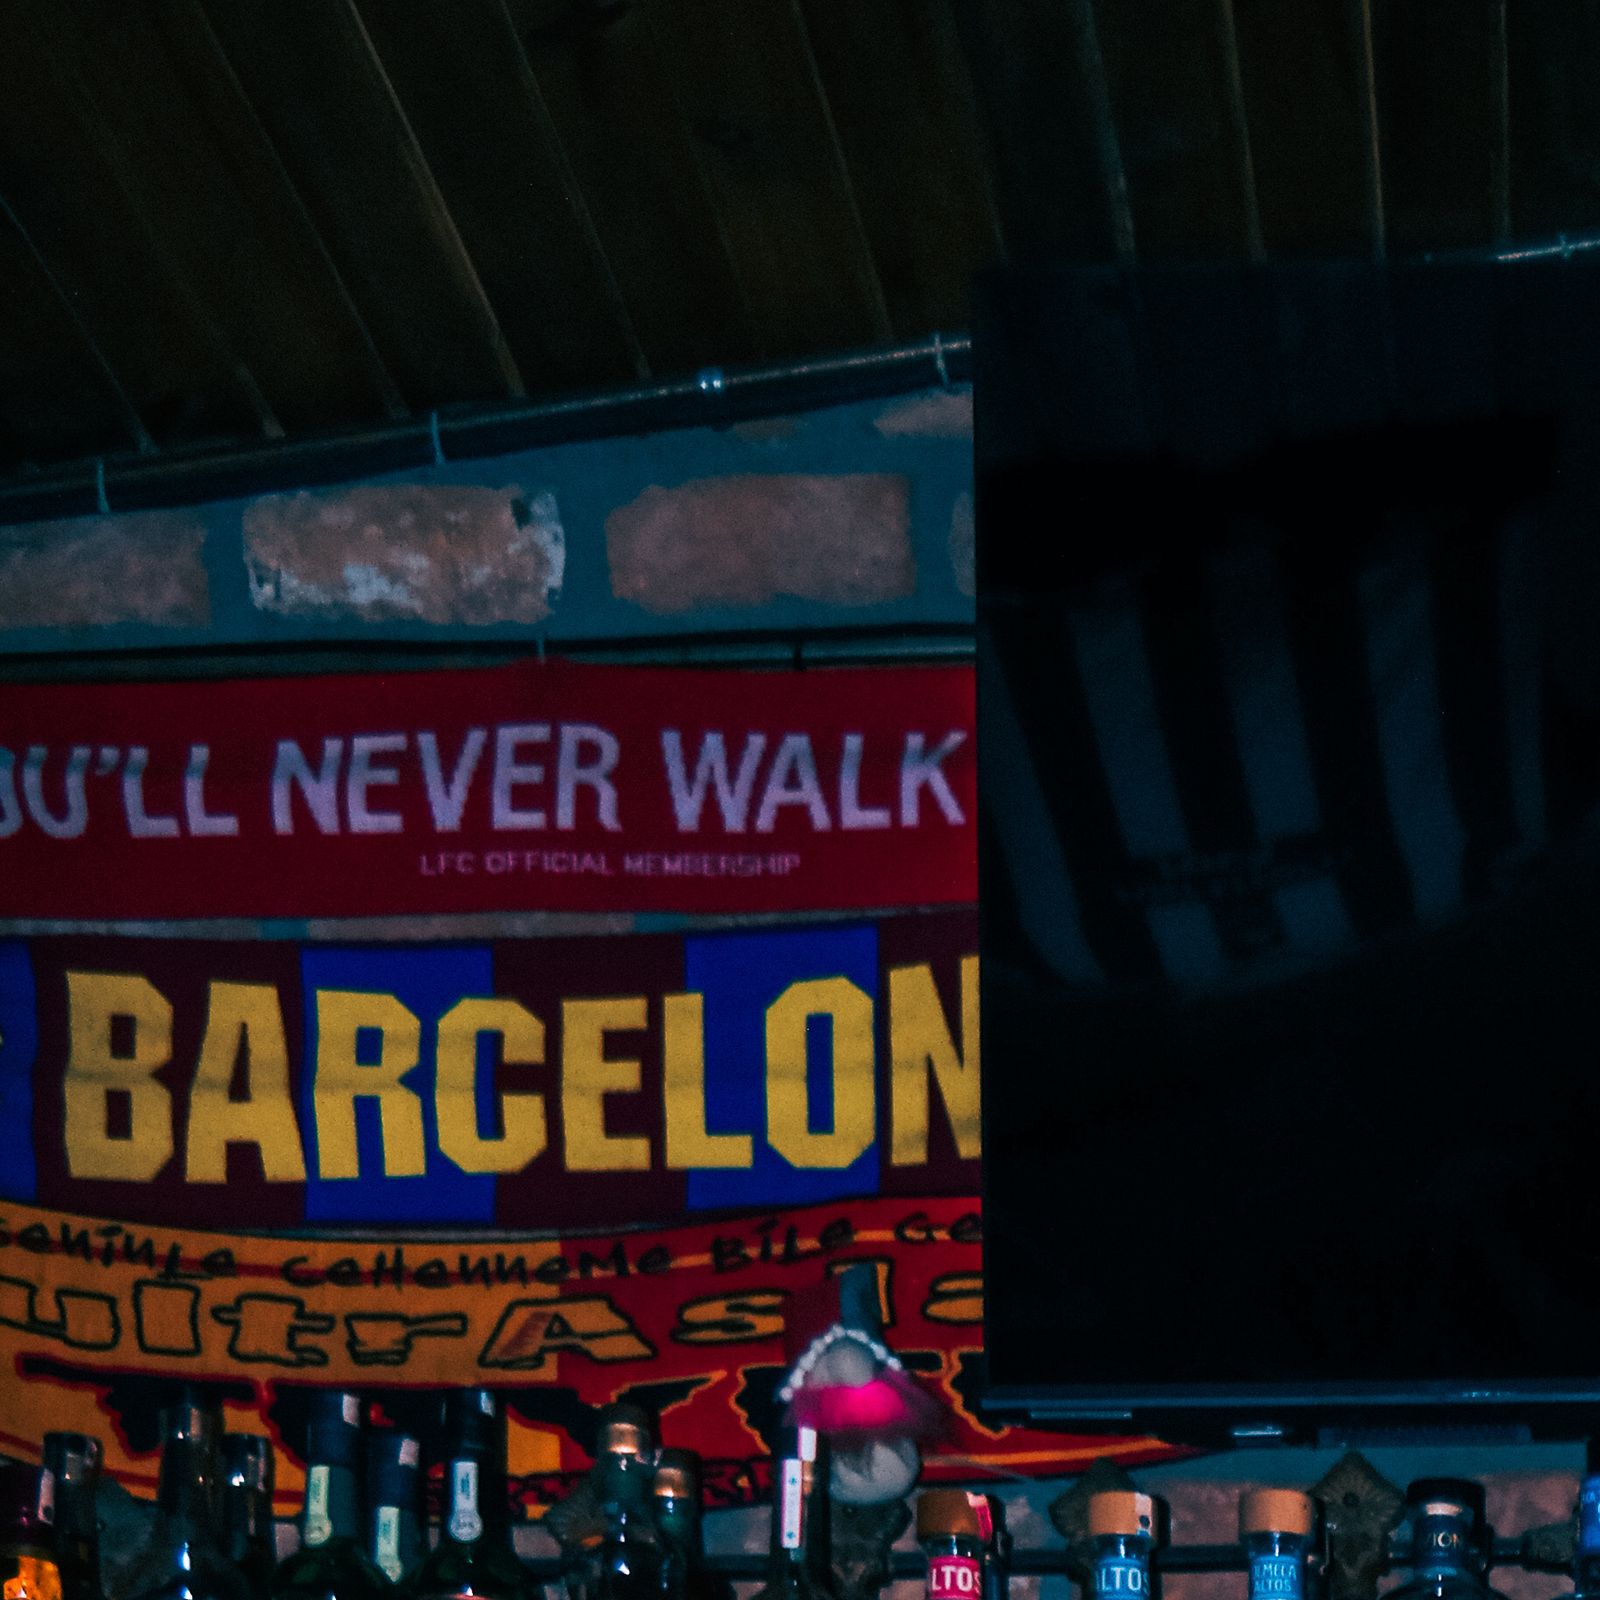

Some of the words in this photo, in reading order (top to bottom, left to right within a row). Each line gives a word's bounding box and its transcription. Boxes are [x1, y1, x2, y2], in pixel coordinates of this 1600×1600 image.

[270, 724, 624, 837] NEVER
[661, 728, 970, 834] WALK
[420, 853, 475, 877] LFC
[486, 851, 612, 875] OFFICIAL
[623, 853, 802, 878] MEMBERSHIP
